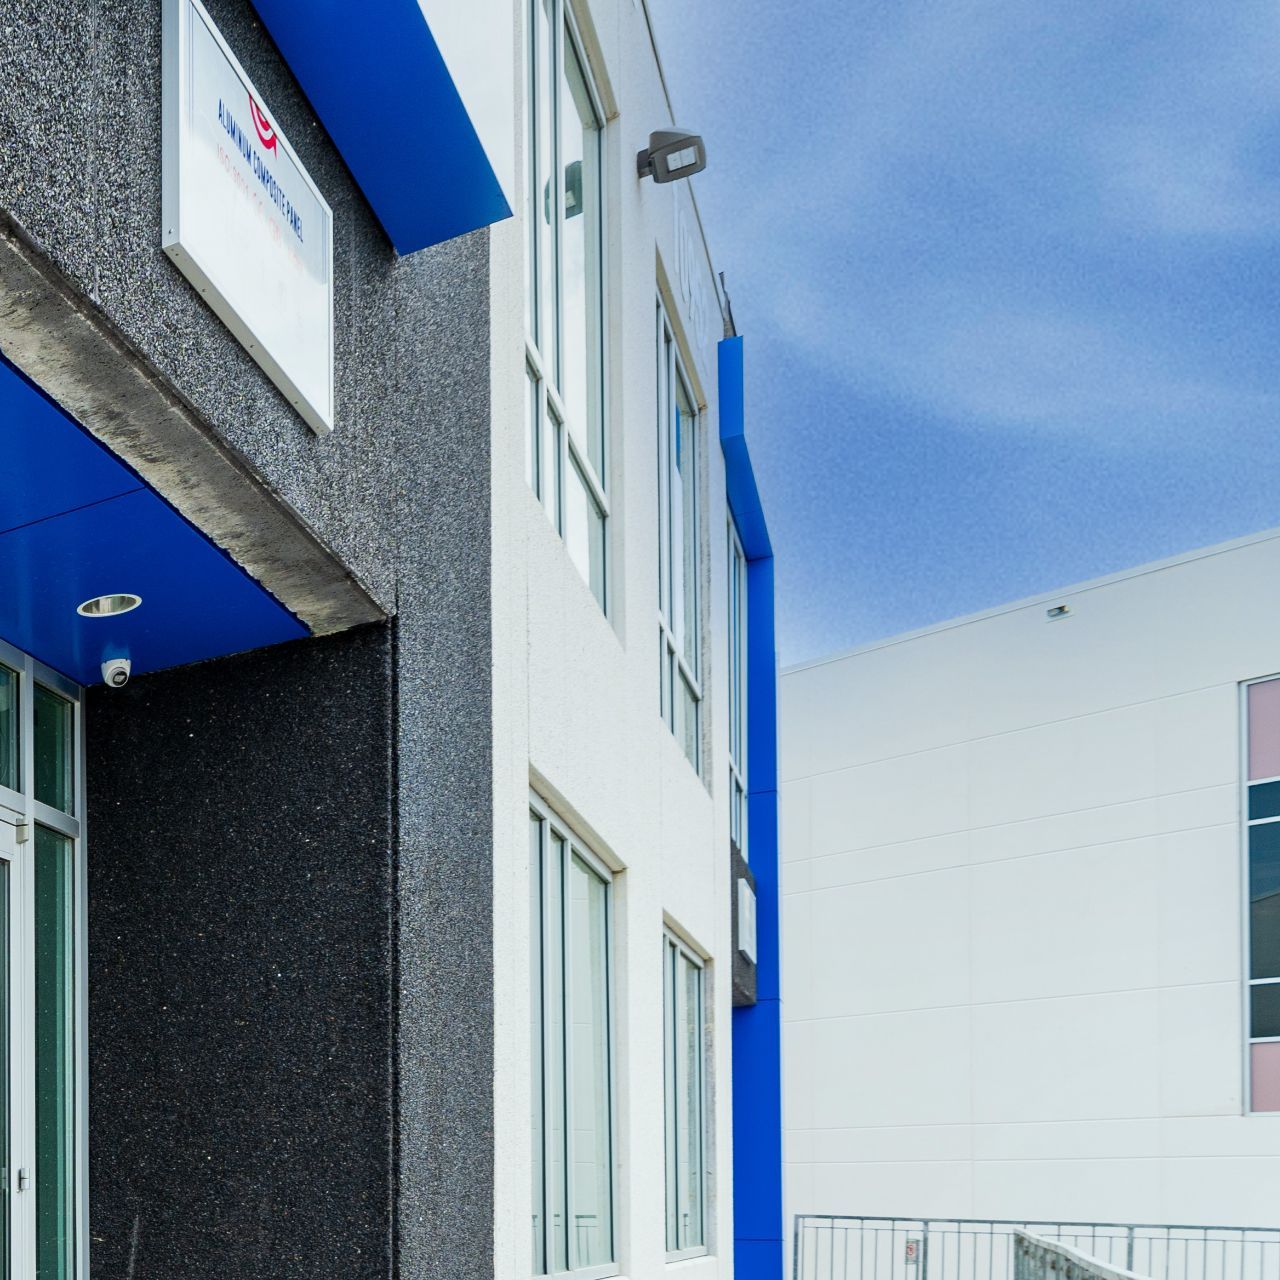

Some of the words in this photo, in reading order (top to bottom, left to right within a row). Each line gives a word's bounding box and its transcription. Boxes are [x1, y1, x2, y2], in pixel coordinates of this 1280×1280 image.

[218, 97, 252, 167] ALUMINUM
[253, 149, 286, 217] COMPOSITE
[286, 199, 304, 244] PANEL
